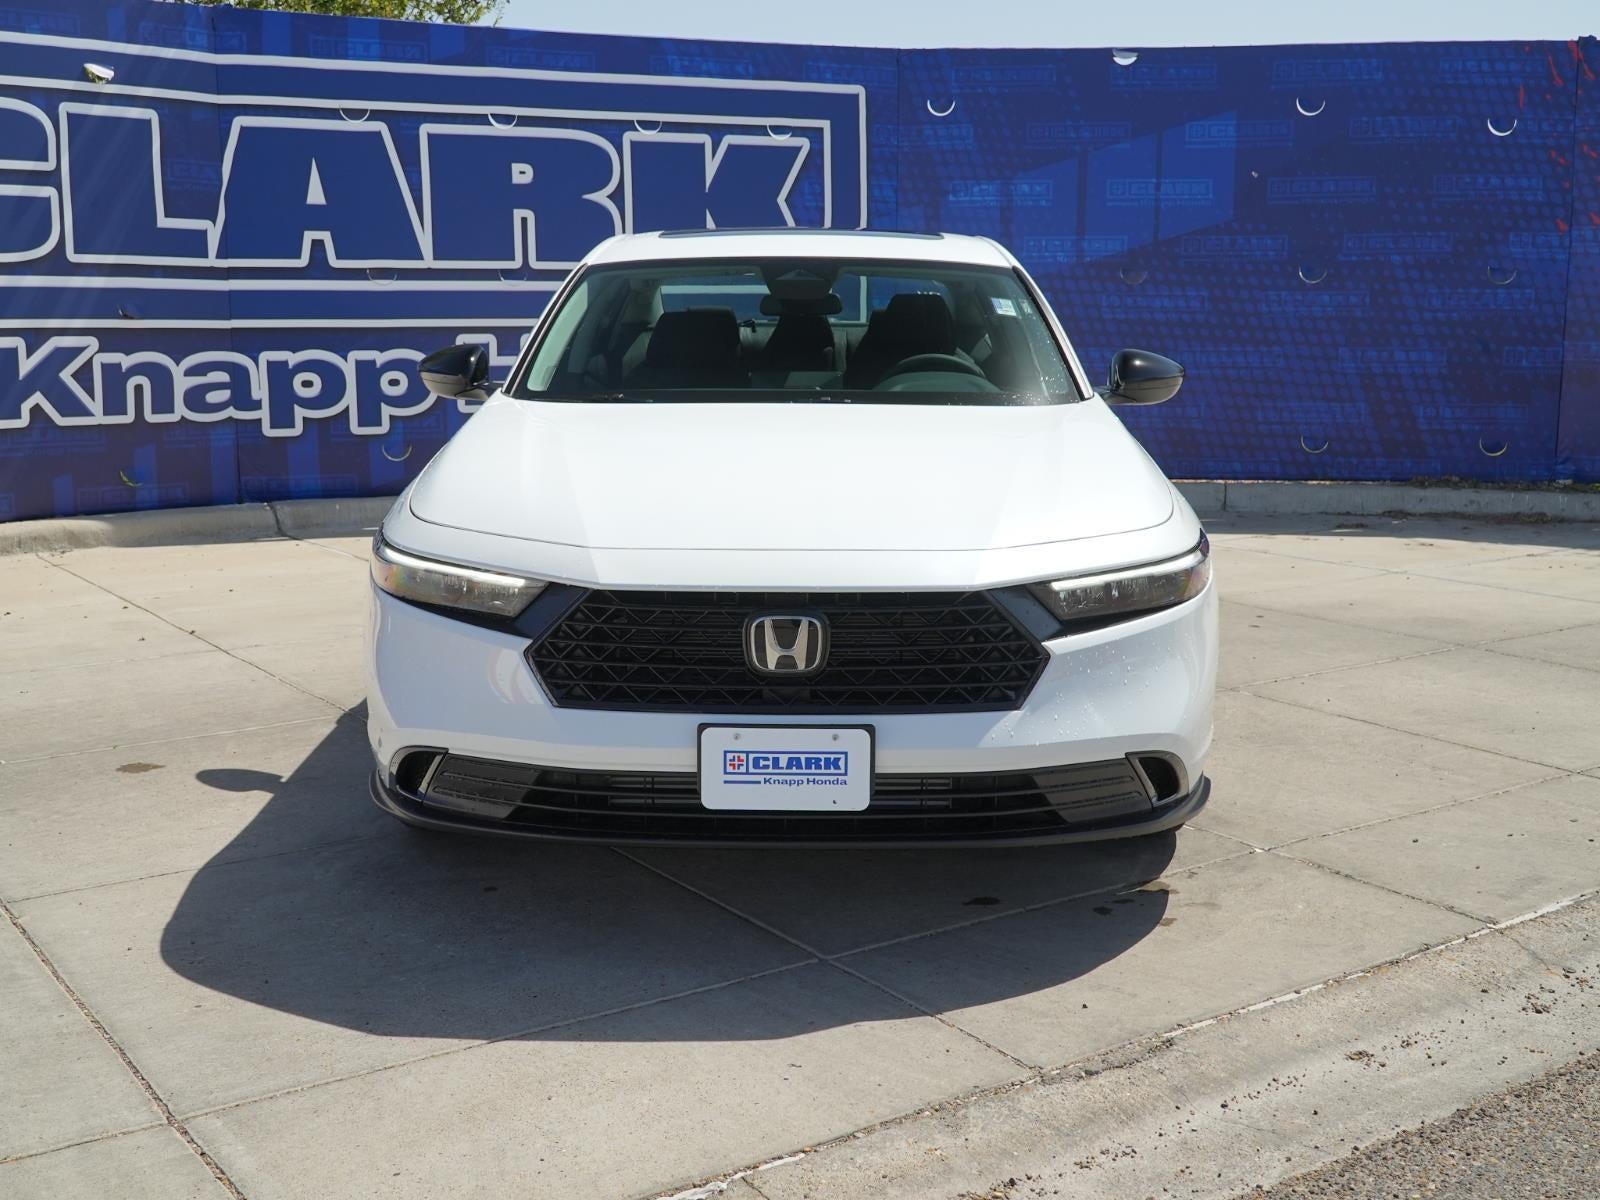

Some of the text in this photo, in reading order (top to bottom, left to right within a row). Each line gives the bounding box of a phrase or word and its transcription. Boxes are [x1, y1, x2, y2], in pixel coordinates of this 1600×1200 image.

[0, 97, 811, 269] LARK
[0, 335, 438, 437] Knapp
[752, 756, 842, 771] CLARK
[763, 777, 848, 787] Knapp Honda
